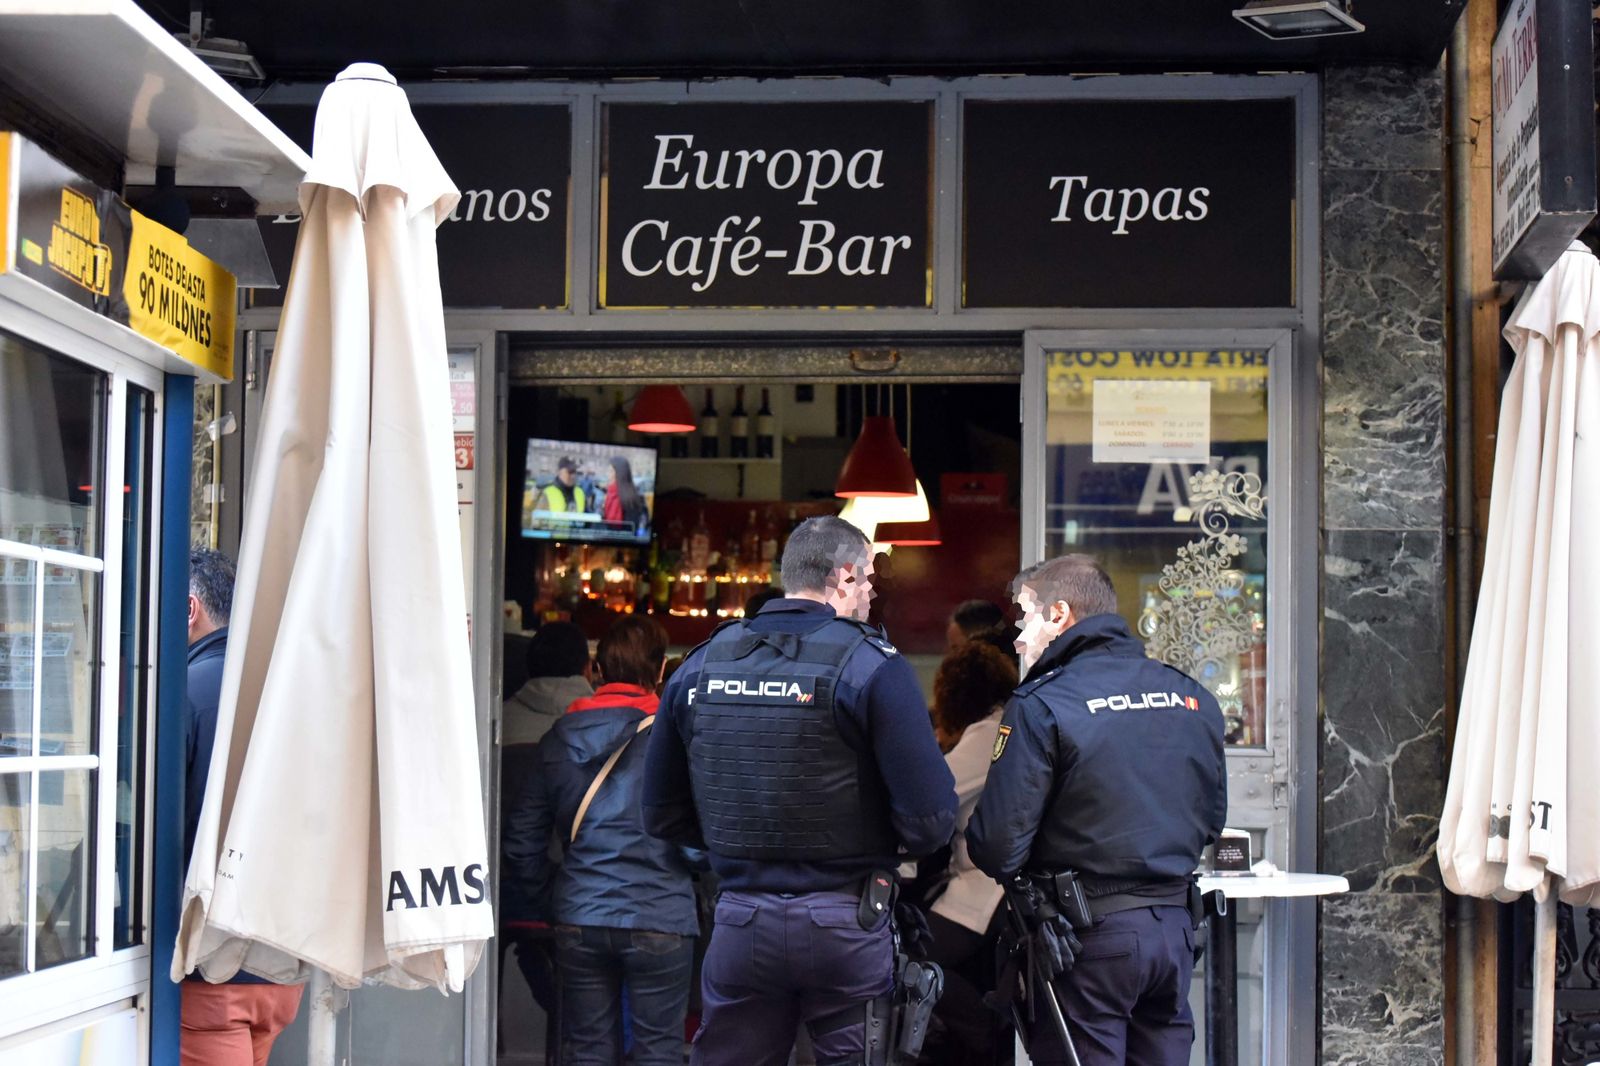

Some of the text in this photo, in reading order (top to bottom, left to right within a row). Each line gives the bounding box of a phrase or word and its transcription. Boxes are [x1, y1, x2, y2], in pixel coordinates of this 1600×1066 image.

[643, 134, 884, 205] Europa
[1049, 176, 1210, 235] Tapas
[148, 245, 174, 281] BOTES
[621, 215, 912, 292] Café-Bar
[139, 271, 155, 314] 90
[707, 679, 802, 697] POLICIA
[1086, 692, 1186, 714] POLICIA
[386, 863, 485, 912] AMS
